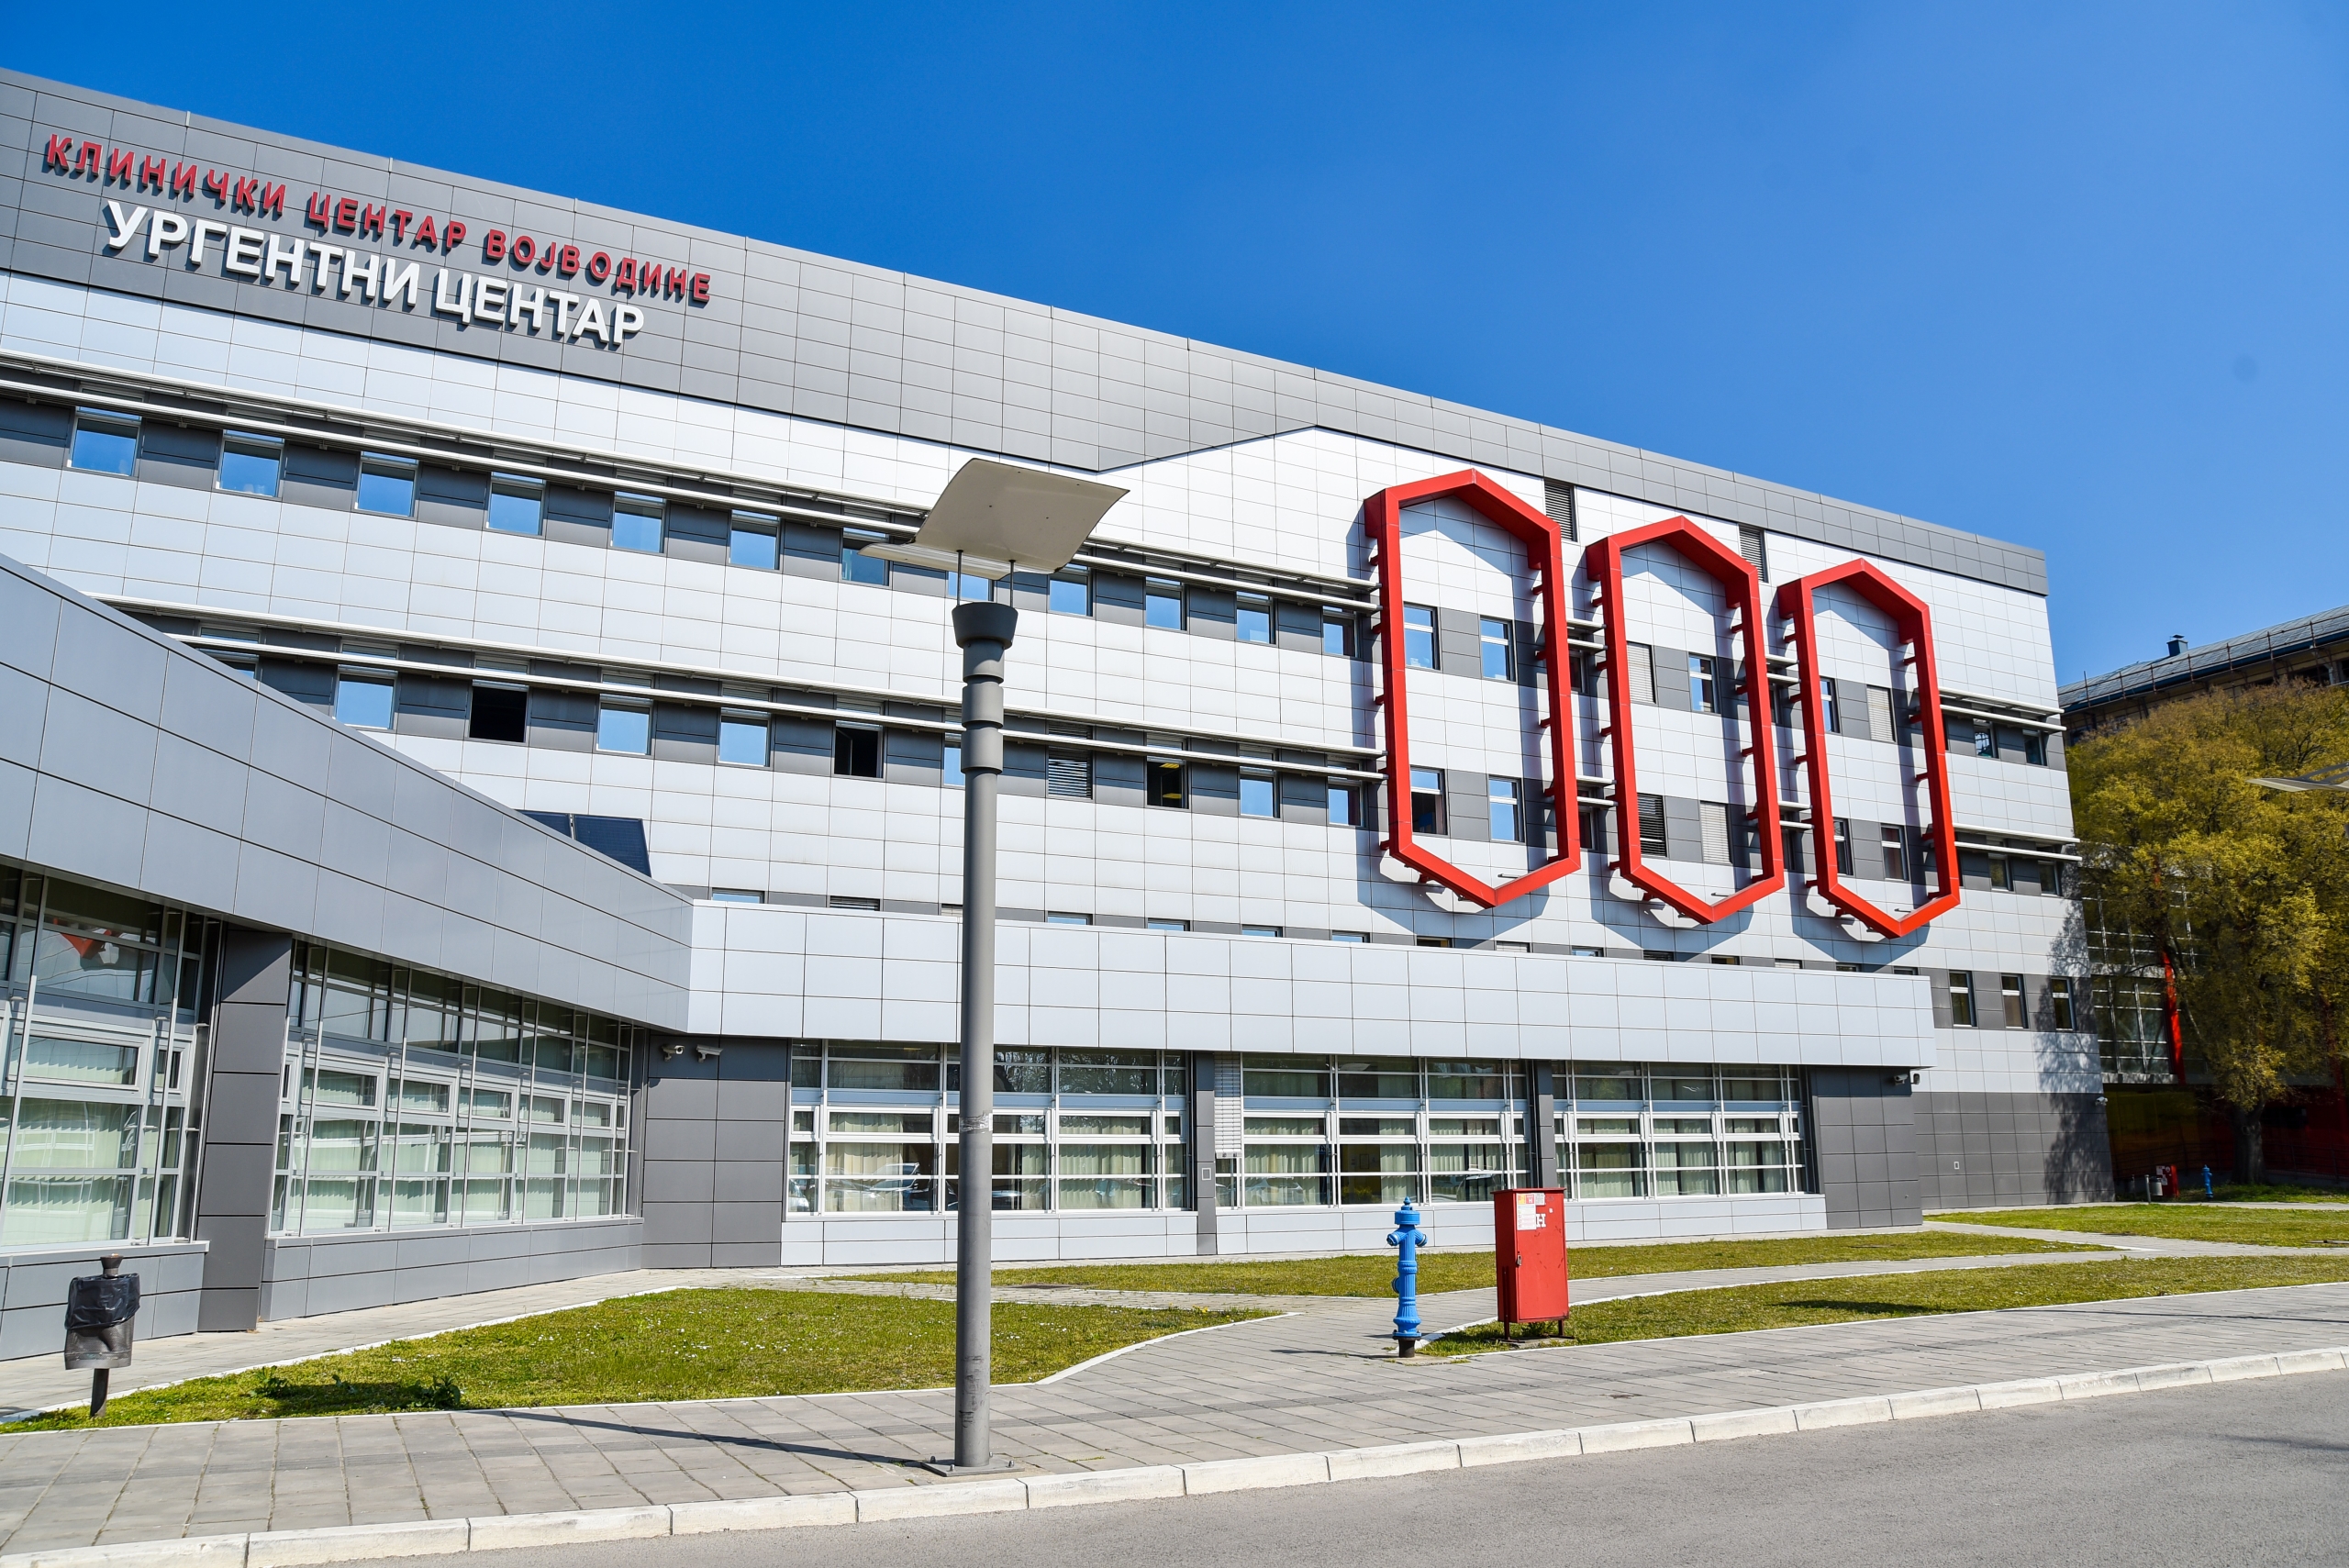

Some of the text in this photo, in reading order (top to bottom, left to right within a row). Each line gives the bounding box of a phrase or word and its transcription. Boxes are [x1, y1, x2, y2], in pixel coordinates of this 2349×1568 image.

[46, 133, 711, 302] КЛИНИЧКИ ЦЕНТАР ВОЈВОДИНЕ
[106, 199, 645, 346] УРГЕНТНИ ЦЕНТАР
